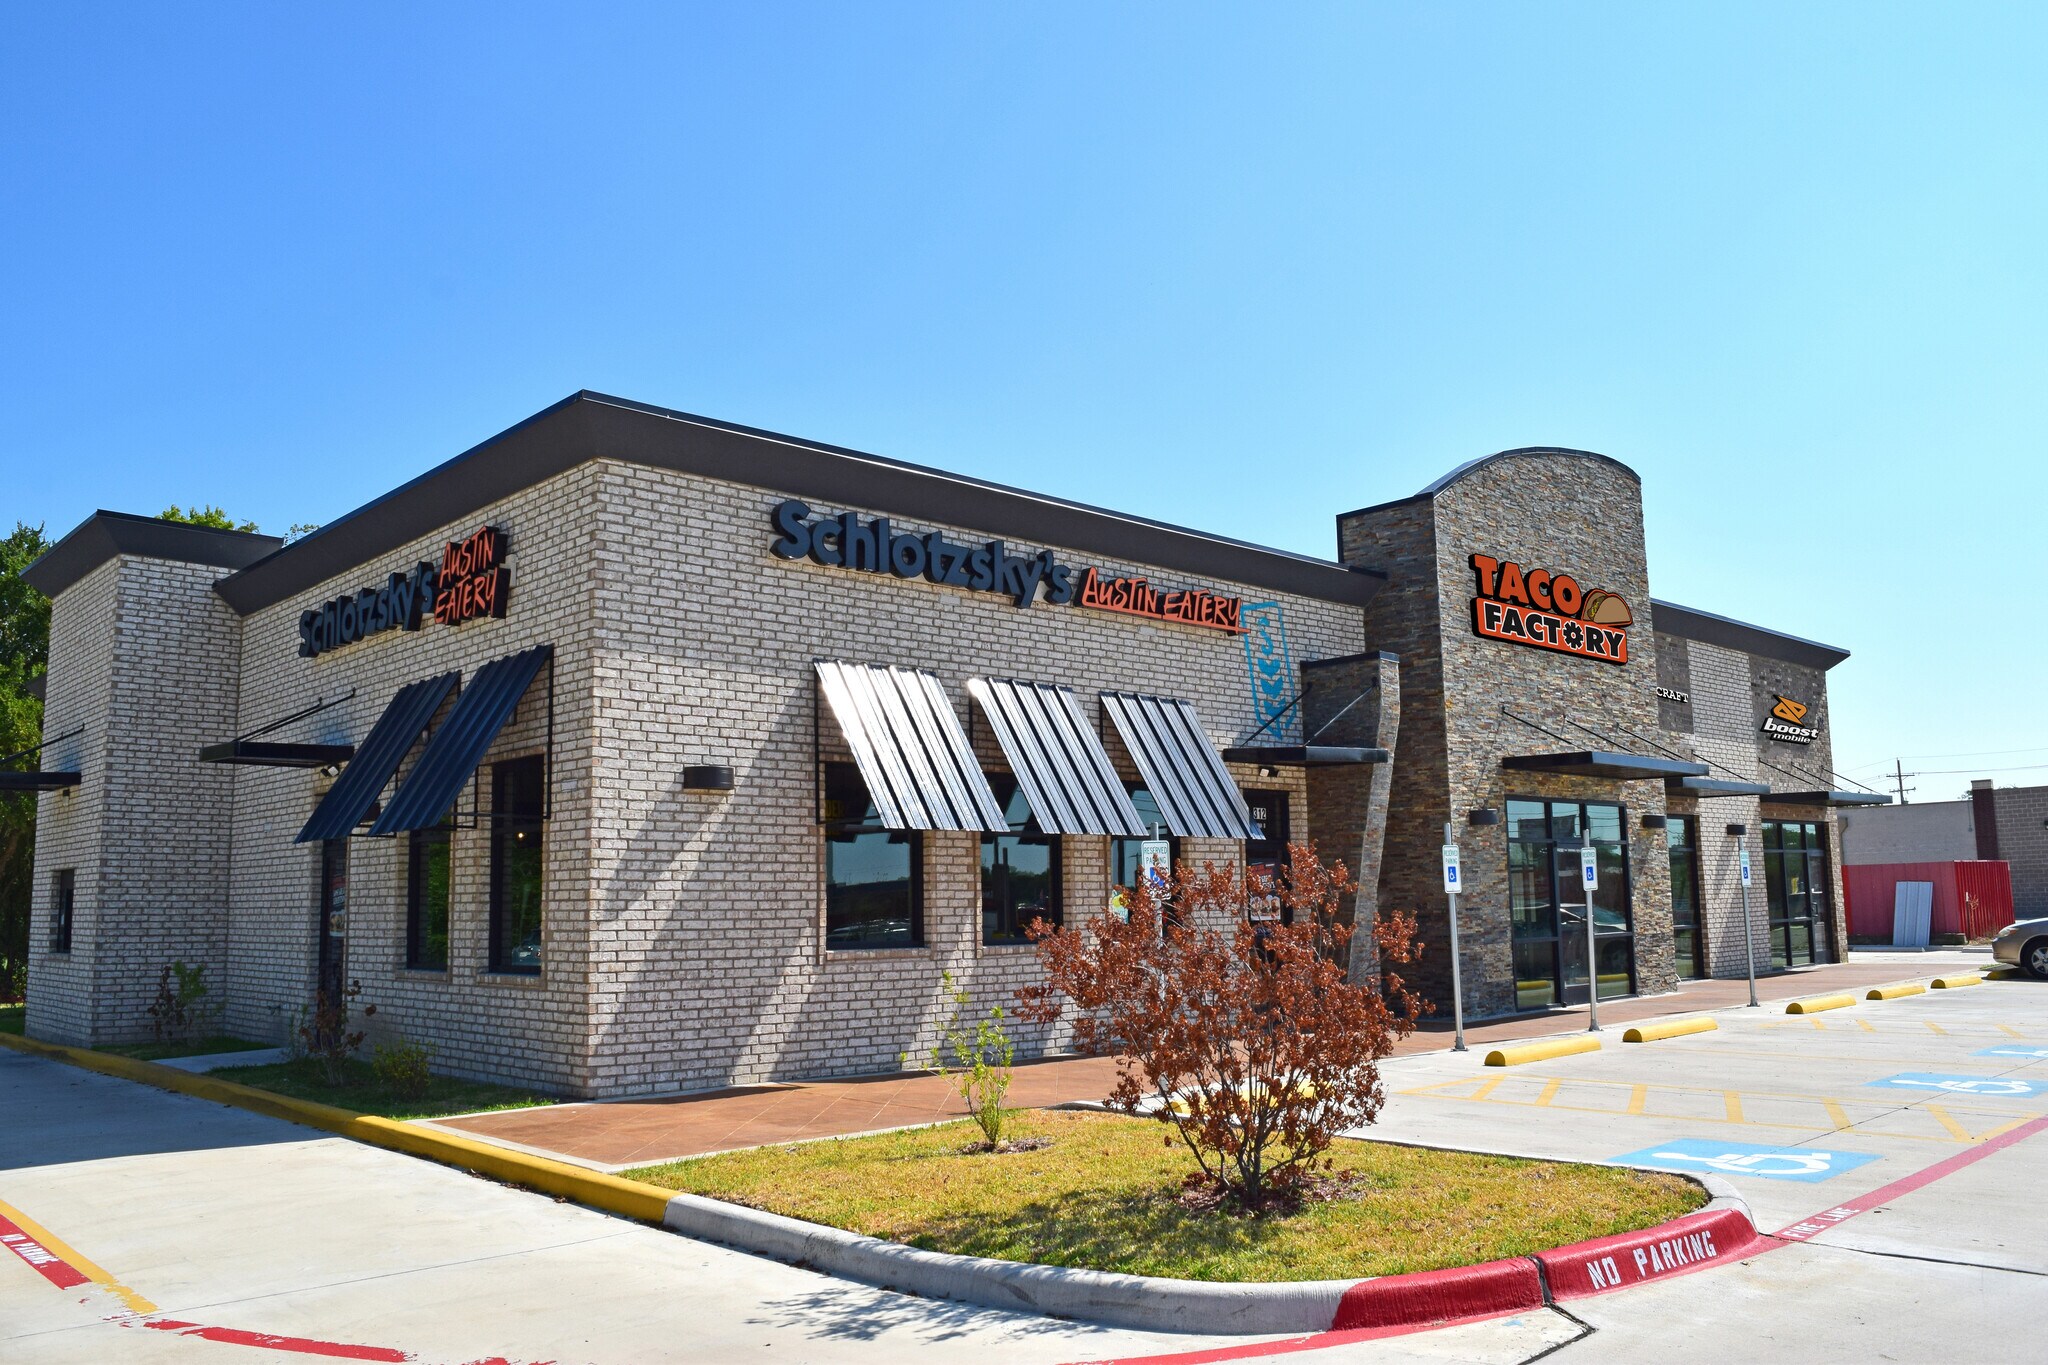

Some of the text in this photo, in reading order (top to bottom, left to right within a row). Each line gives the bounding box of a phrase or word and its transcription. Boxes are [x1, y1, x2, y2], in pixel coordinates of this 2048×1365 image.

[437, 526, 496, 588] AUSTIN
[769, 499, 1073, 609] Schlotzsky's
[298, 562, 435, 657] Schlotzsky's
[434, 567, 500, 626] EATERY
[1080, 566, 1243, 632] AUSTIN EATERY
[1472, 554, 1582, 615] TACO
[1483, 601, 1624, 659] FACTORY
[1763, 717, 1819, 738] boost
[1773, 733, 1811, 744] mobile
[1253, 808, 1266, 819] 312
[1144, 846, 1168, 854] RESERVED
[1781, 1206, 1861, 1239] FIRE LANE
[1586, 1230, 1718, 1290] NO PARKING
